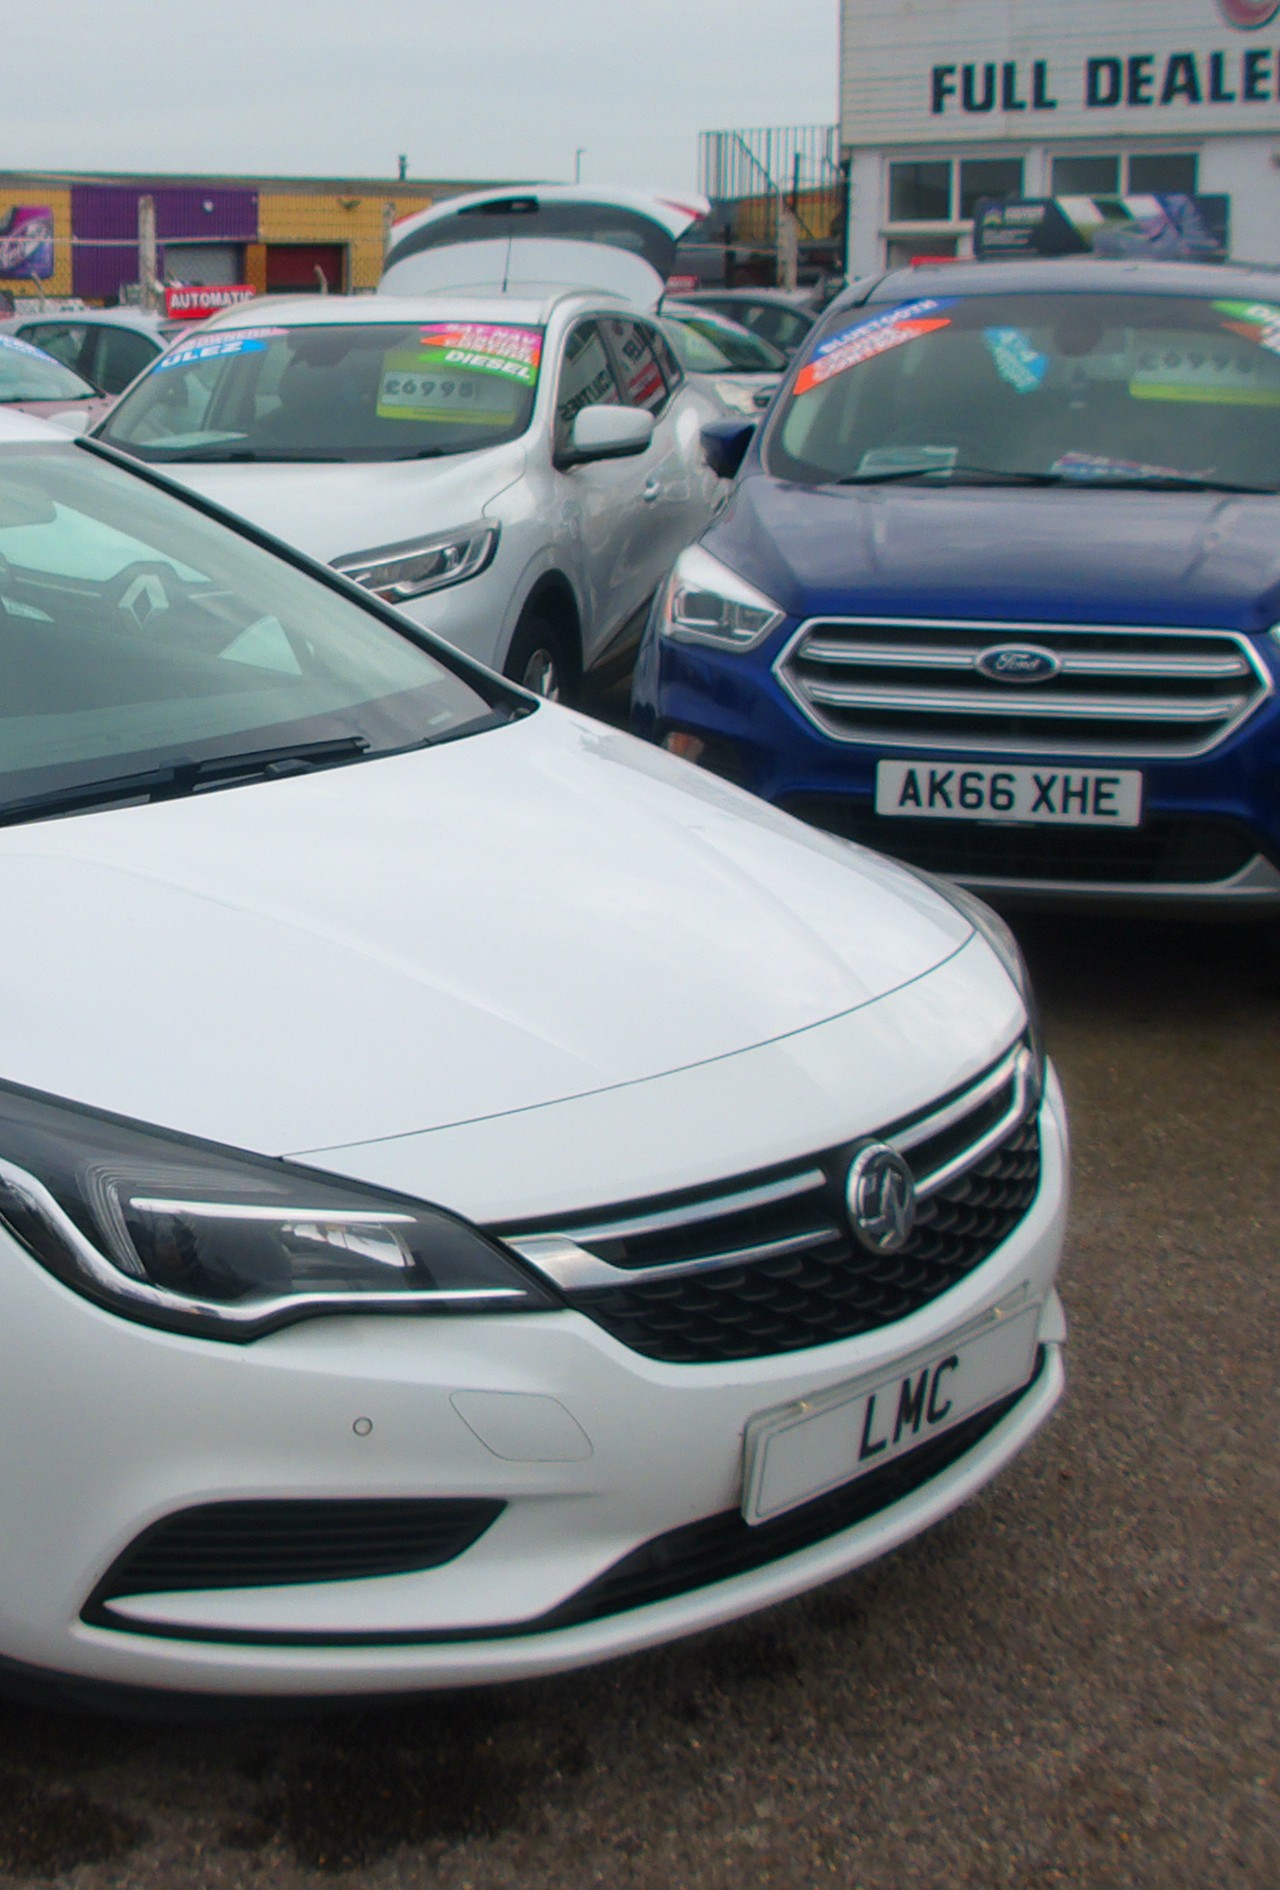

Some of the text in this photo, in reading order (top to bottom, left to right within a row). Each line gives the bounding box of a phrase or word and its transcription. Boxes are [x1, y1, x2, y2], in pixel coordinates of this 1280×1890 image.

[931, 50, 1280, 114] FULL DEALE
[171, 291, 254, 309] AUTOMATIC
[161, 341, 245, 367] ULEZ
[445, 351, 531, 380] DIESEL
[995, 653, 1041, 672] Ford
[899, 768, 1121, 816] AK66 XHE
[858, 1354, 959, 1461] LMC
